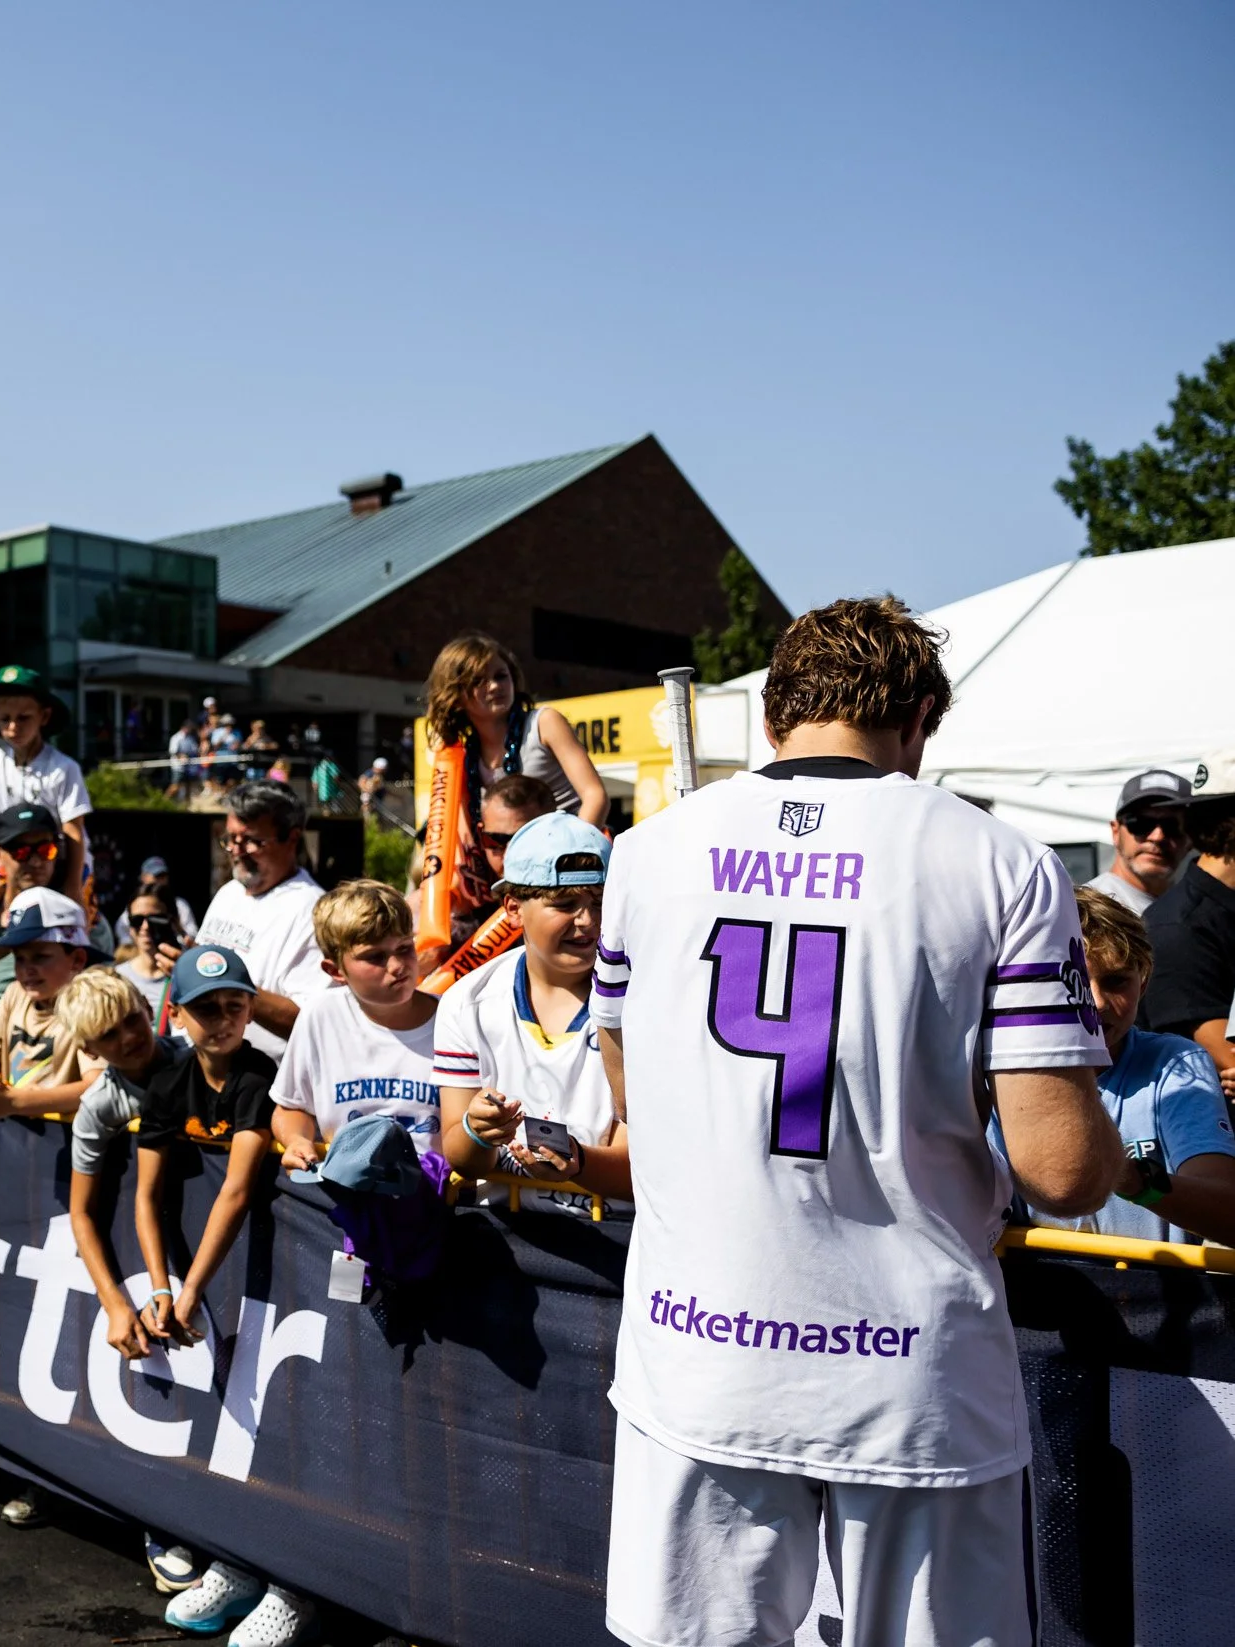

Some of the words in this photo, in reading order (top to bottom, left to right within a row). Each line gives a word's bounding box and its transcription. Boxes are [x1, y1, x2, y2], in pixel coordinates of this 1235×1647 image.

[576, 716, 621, 754] ORE
[709, 848, 864, 900] WAYER
[699, 917, 847, 1161] 4
[335, 1078, 441, 1108] KENNEBUN
[650, 1289, 920, 1357] ticketmaster
